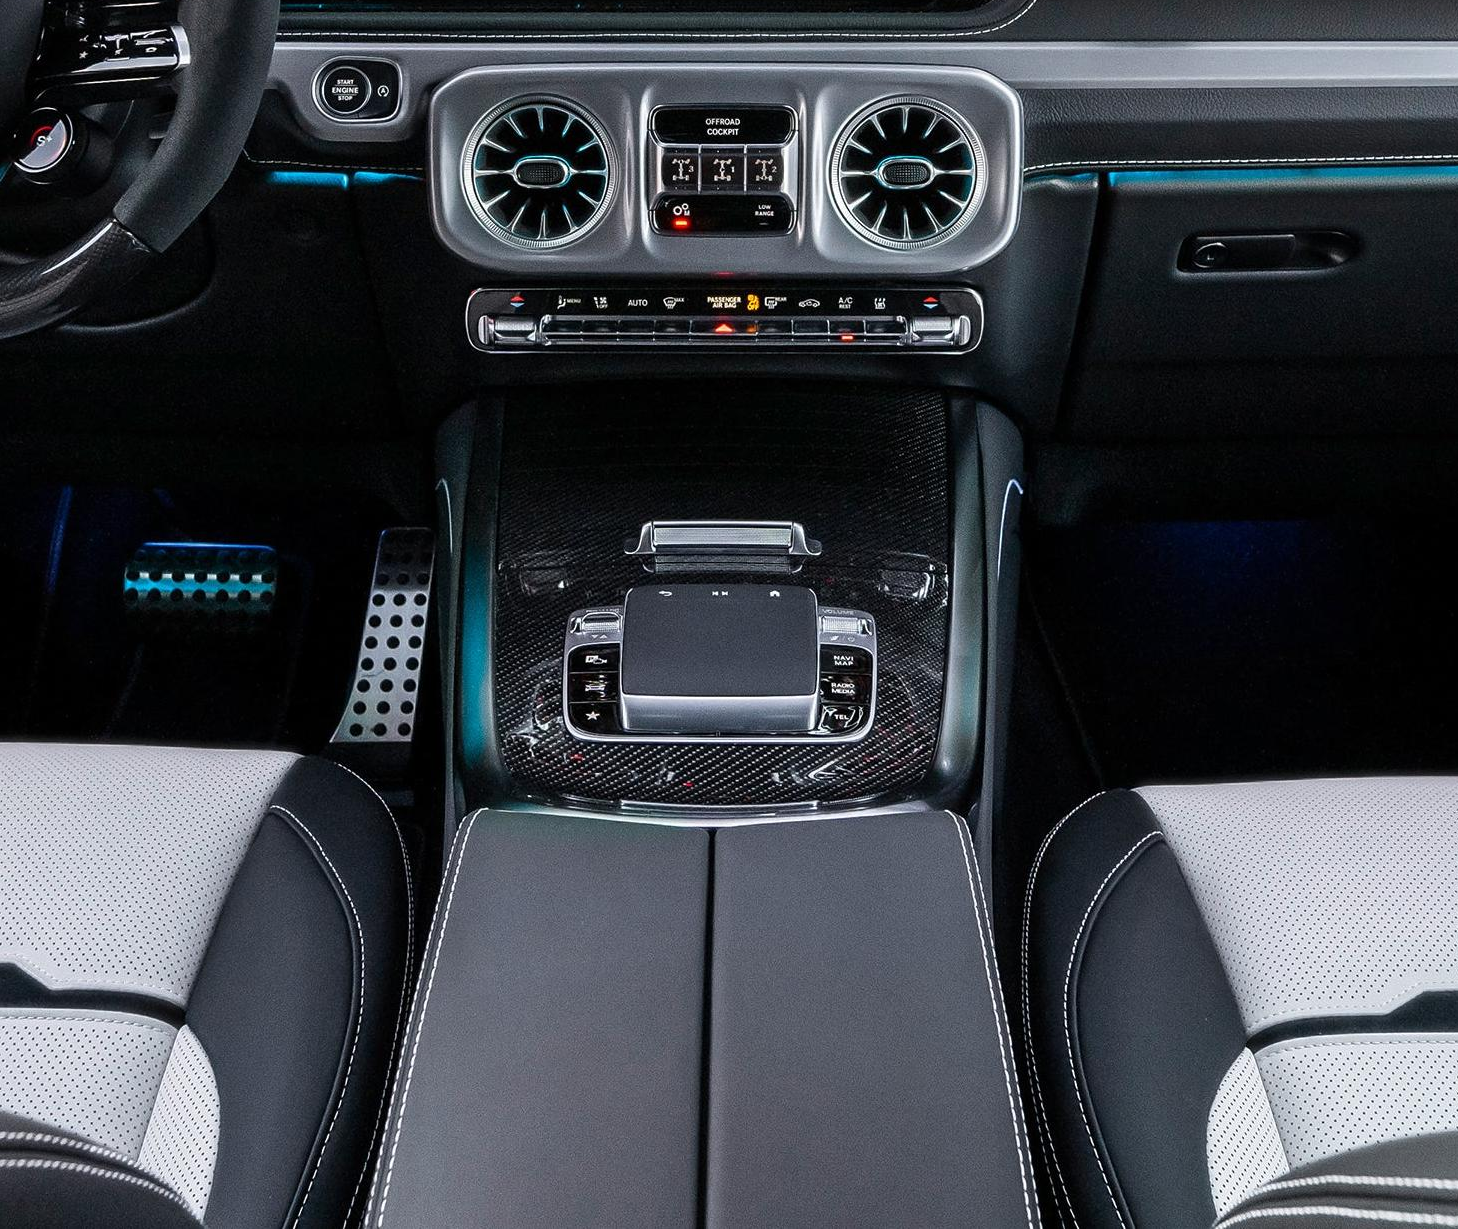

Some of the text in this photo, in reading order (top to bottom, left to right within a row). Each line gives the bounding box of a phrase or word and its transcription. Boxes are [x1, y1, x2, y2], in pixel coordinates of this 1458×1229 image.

[331, 86, 359, 94] ENGINE
[705, 118, 741, 126] OFFROAD
[706, 128, 740, 136] COCKPIT
[688, 165, 694, 173] 3
[771, 165, 778, 173] 2
[627, 299, 648, 307] AUTO
[838, 296, 853, 304] A/C
